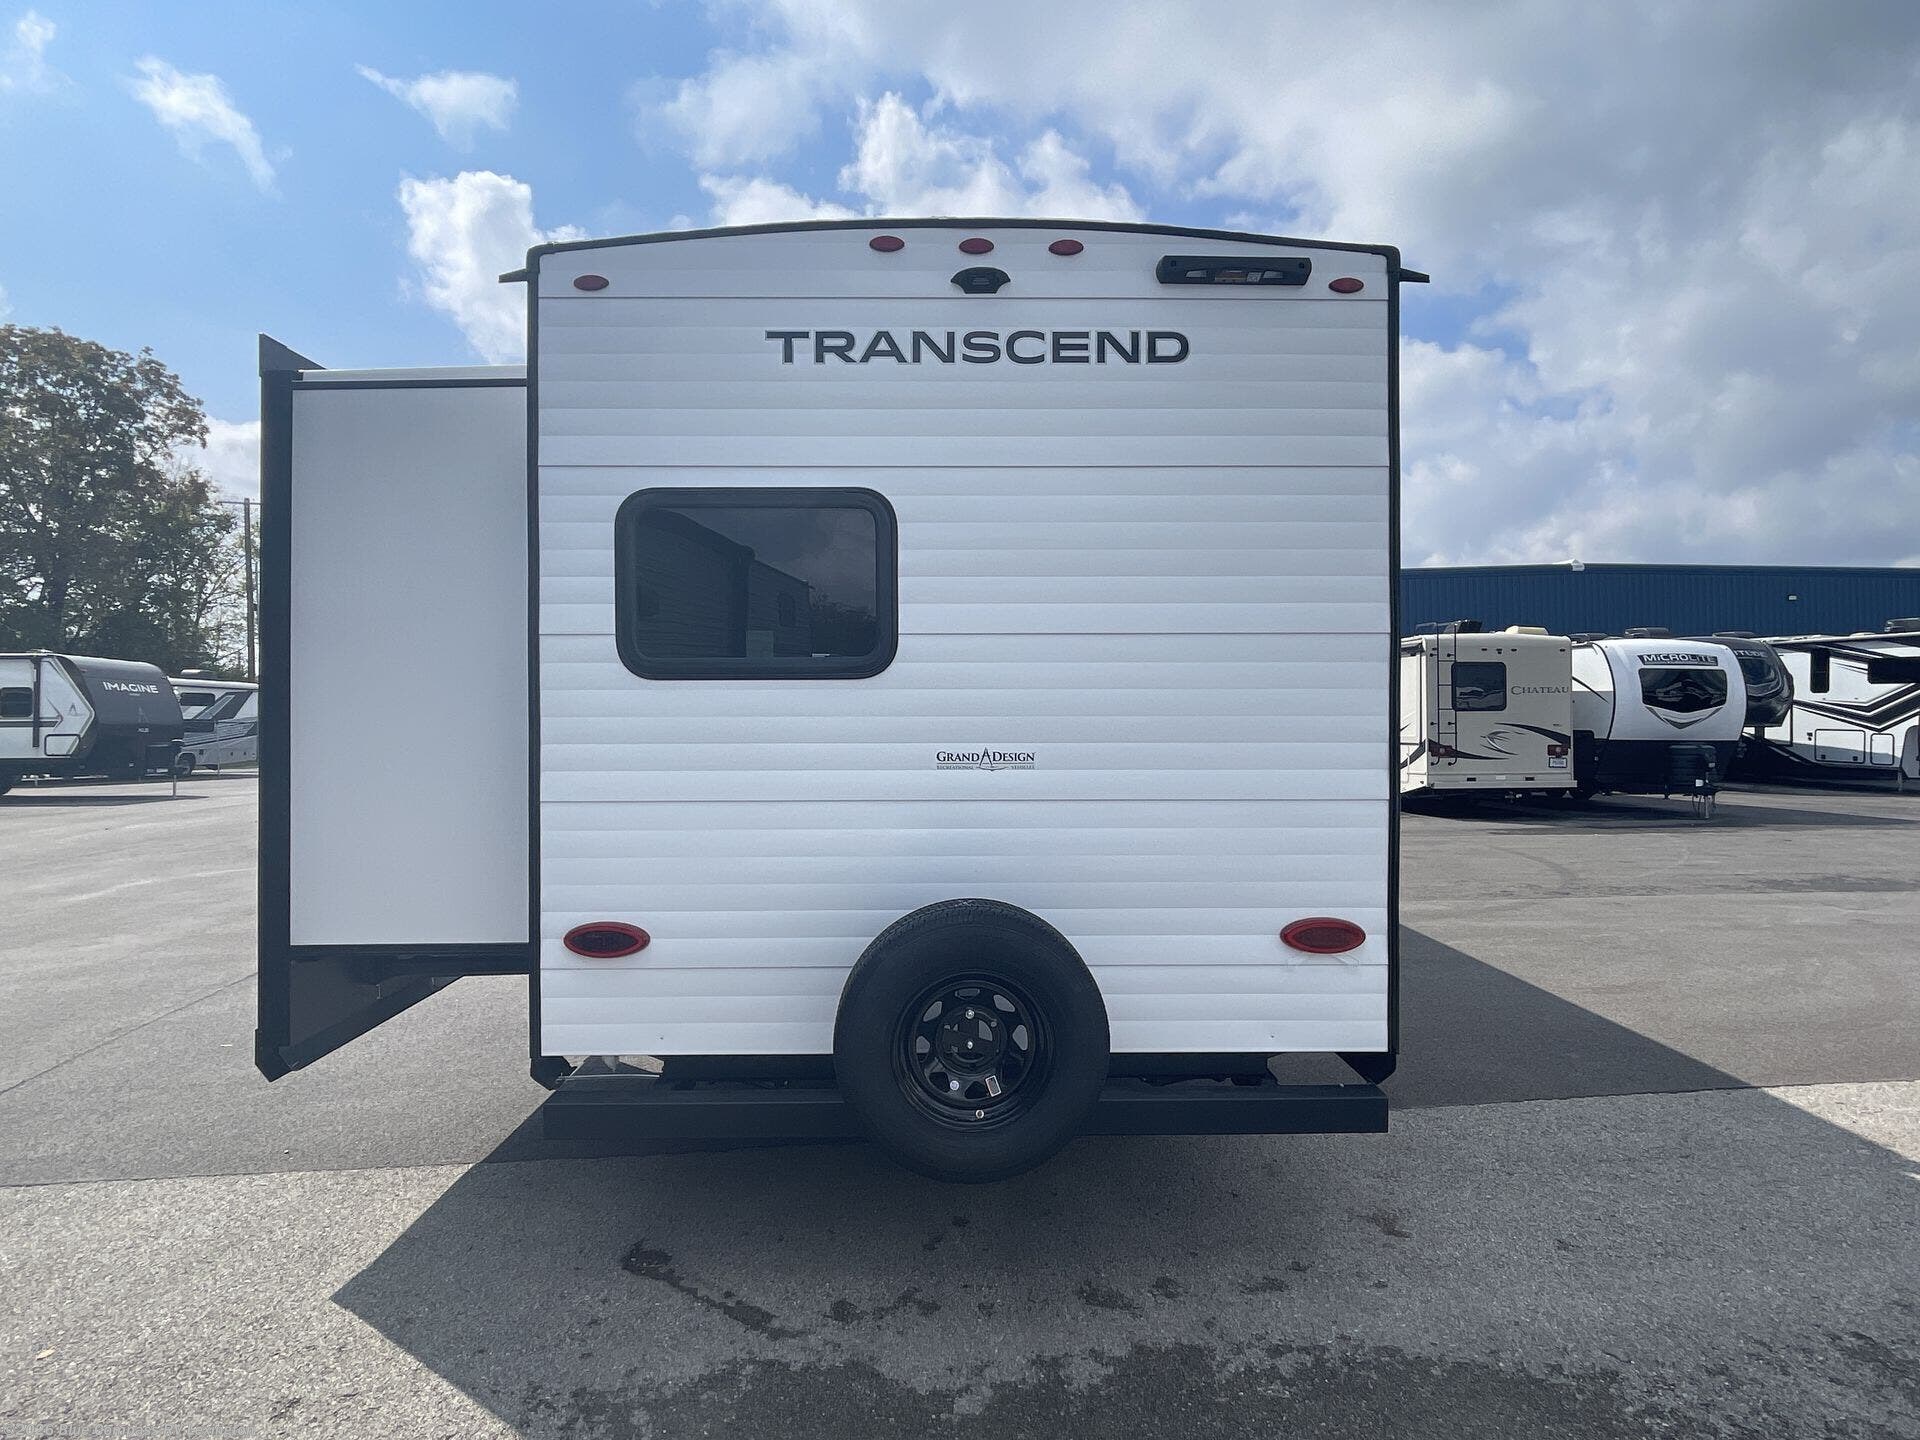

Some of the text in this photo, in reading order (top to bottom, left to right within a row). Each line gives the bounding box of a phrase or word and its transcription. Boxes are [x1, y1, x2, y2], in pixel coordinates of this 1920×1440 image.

[765, 330, 1190, 364] TRANSCEND
[103, 681, 159, 694] IMAGINE
[1511, 685, 1569, 695] CHATEAU
[936, 751, 1035, 762] GRAND DESIGN
